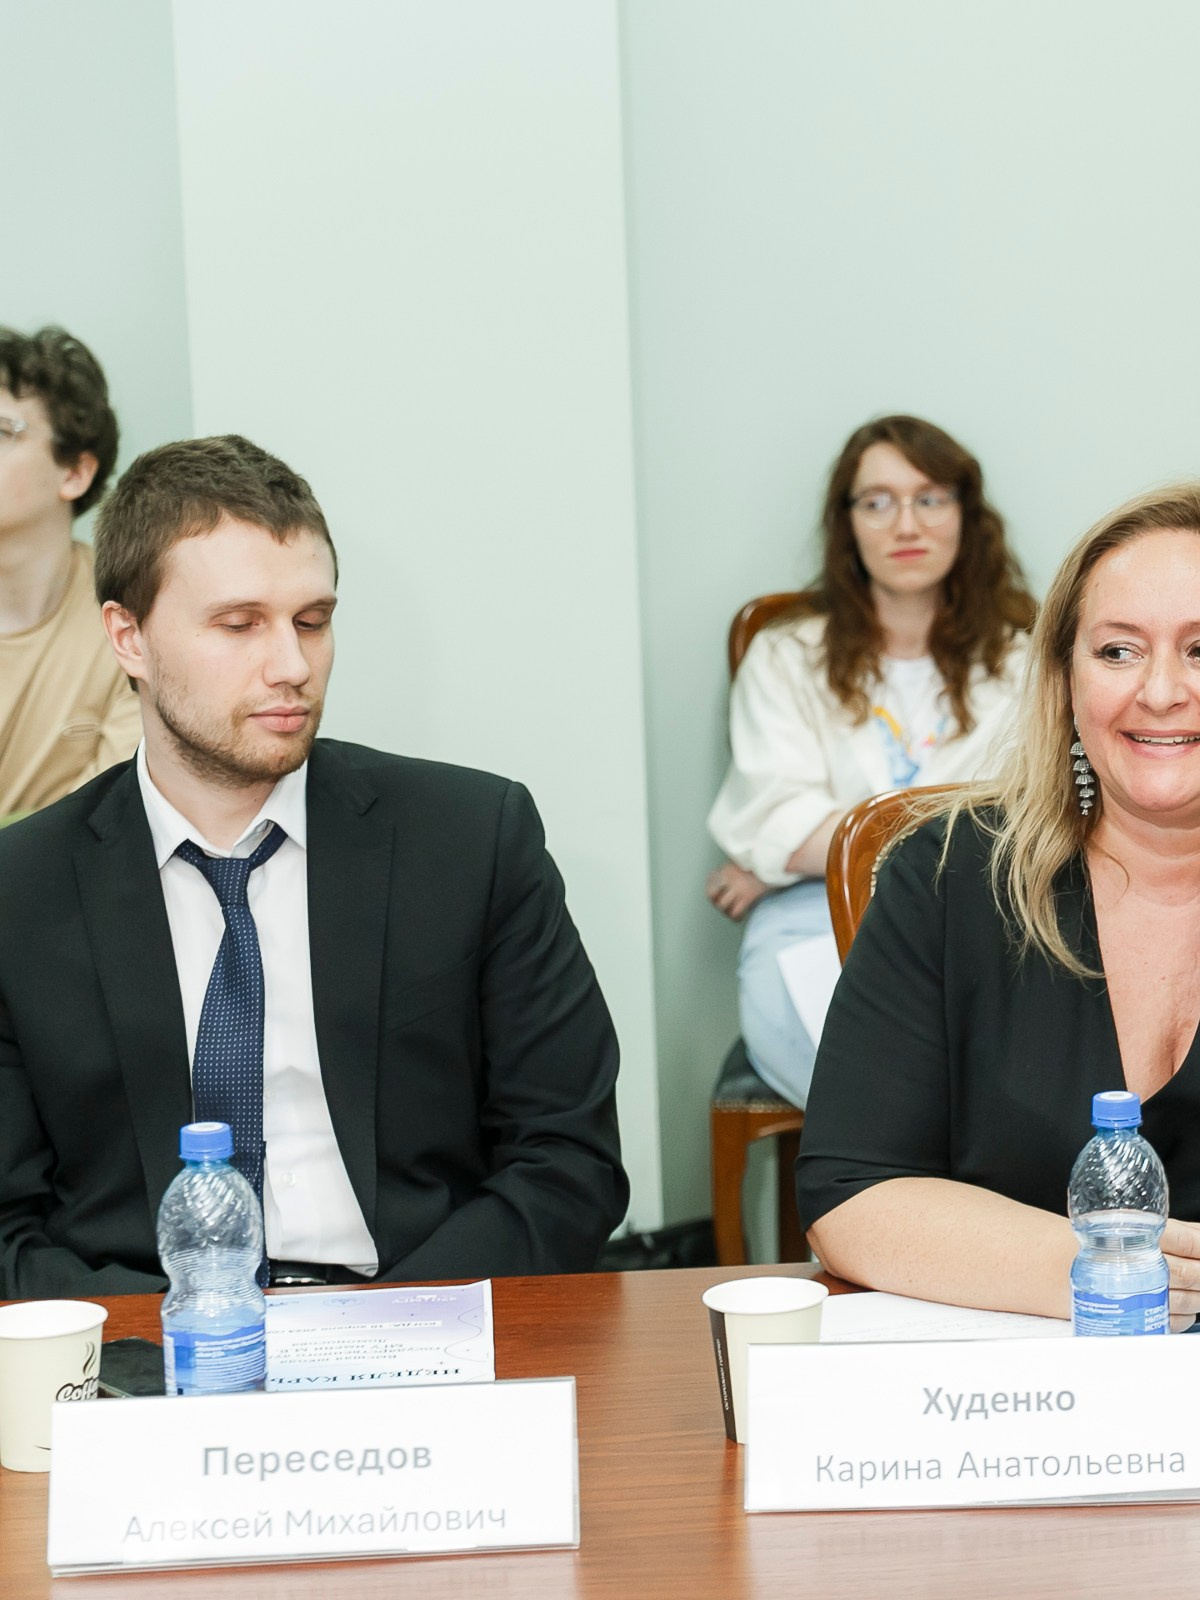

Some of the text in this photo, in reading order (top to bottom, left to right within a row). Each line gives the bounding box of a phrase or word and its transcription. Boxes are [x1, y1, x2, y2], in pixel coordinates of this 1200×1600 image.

[269, 1368, 461, 1385] НЕДЕЛЯ КАРЬ
[922, 1386, 1076, 1422] Худенко
[202, 1446, 432, 1482] Переседов
[816, 1450, 1186, 1489] Карина Анатольевна
[122, 1505, 507, 1545] Алексей Михайлович
